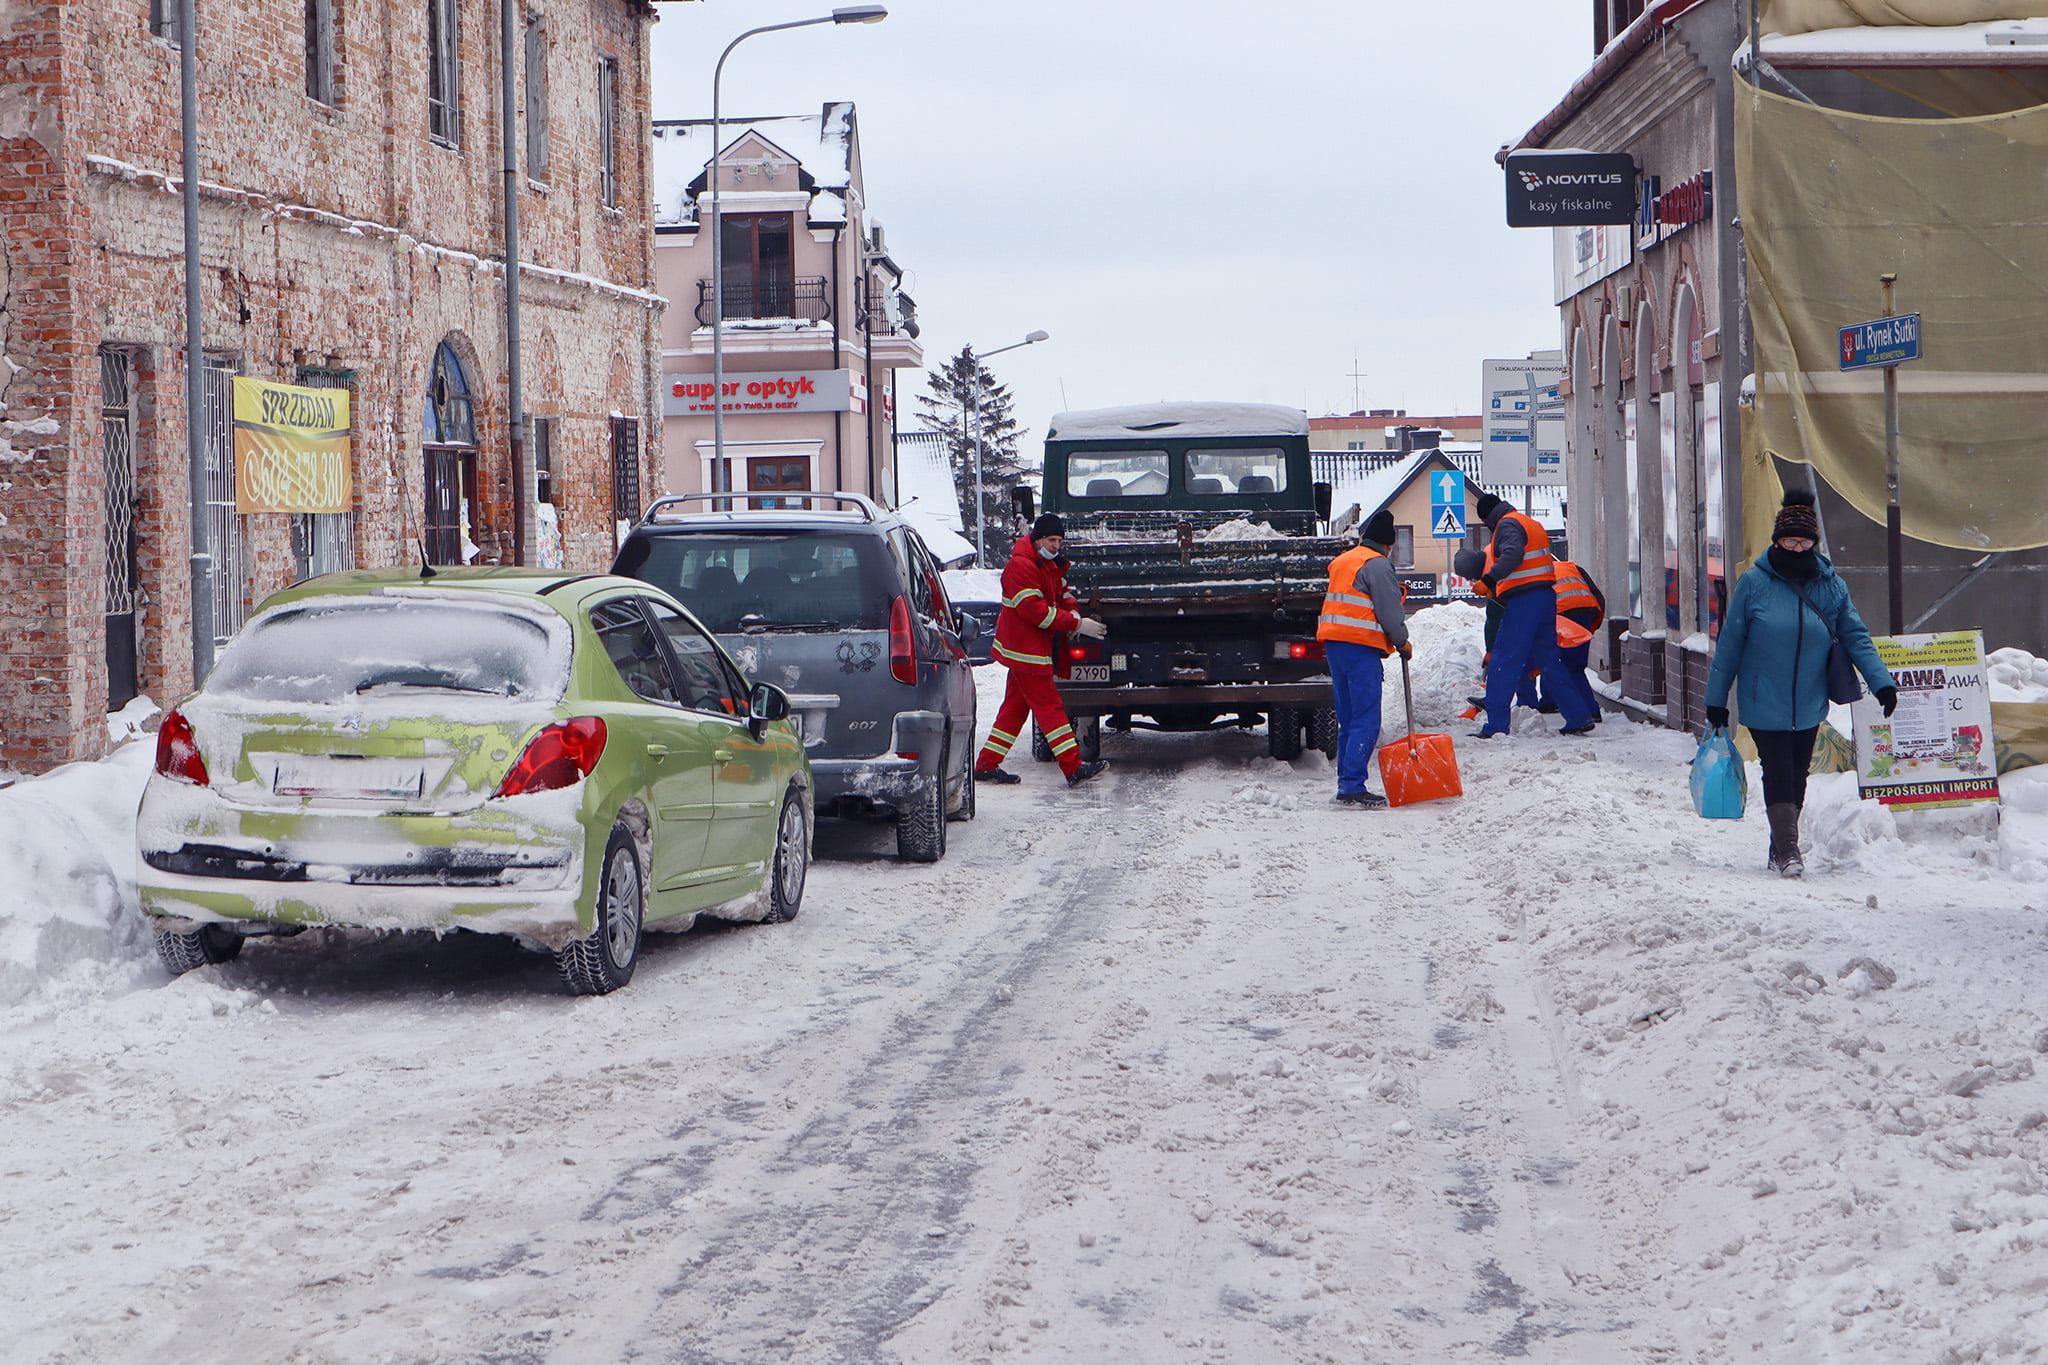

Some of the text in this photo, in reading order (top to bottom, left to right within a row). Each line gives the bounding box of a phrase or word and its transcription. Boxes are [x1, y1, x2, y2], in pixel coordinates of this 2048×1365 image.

[1546, 174, 1622, 185] NOVITUS
[1529, 197, 1612, 214] kasy fiskalne
[1855, 318, 1916, 353] ul. Rynek Sutki
[672, 376, 815, 400] super optyk
[262, 389, 335, 429] SPRZEDAM
[700, 403, 733, 411] TROCE
[743, 402, 773, 410] TWOJE
[322, 452, 343, 508] 380
[1075, 667, 1108, 680] 2Y90
[1890, 669, 1946, 688] KAWA
[1947, 674, 1981, 689] AWA
[1865, 780, 1993, 798] BEZPOŚREDNI IMPORT
